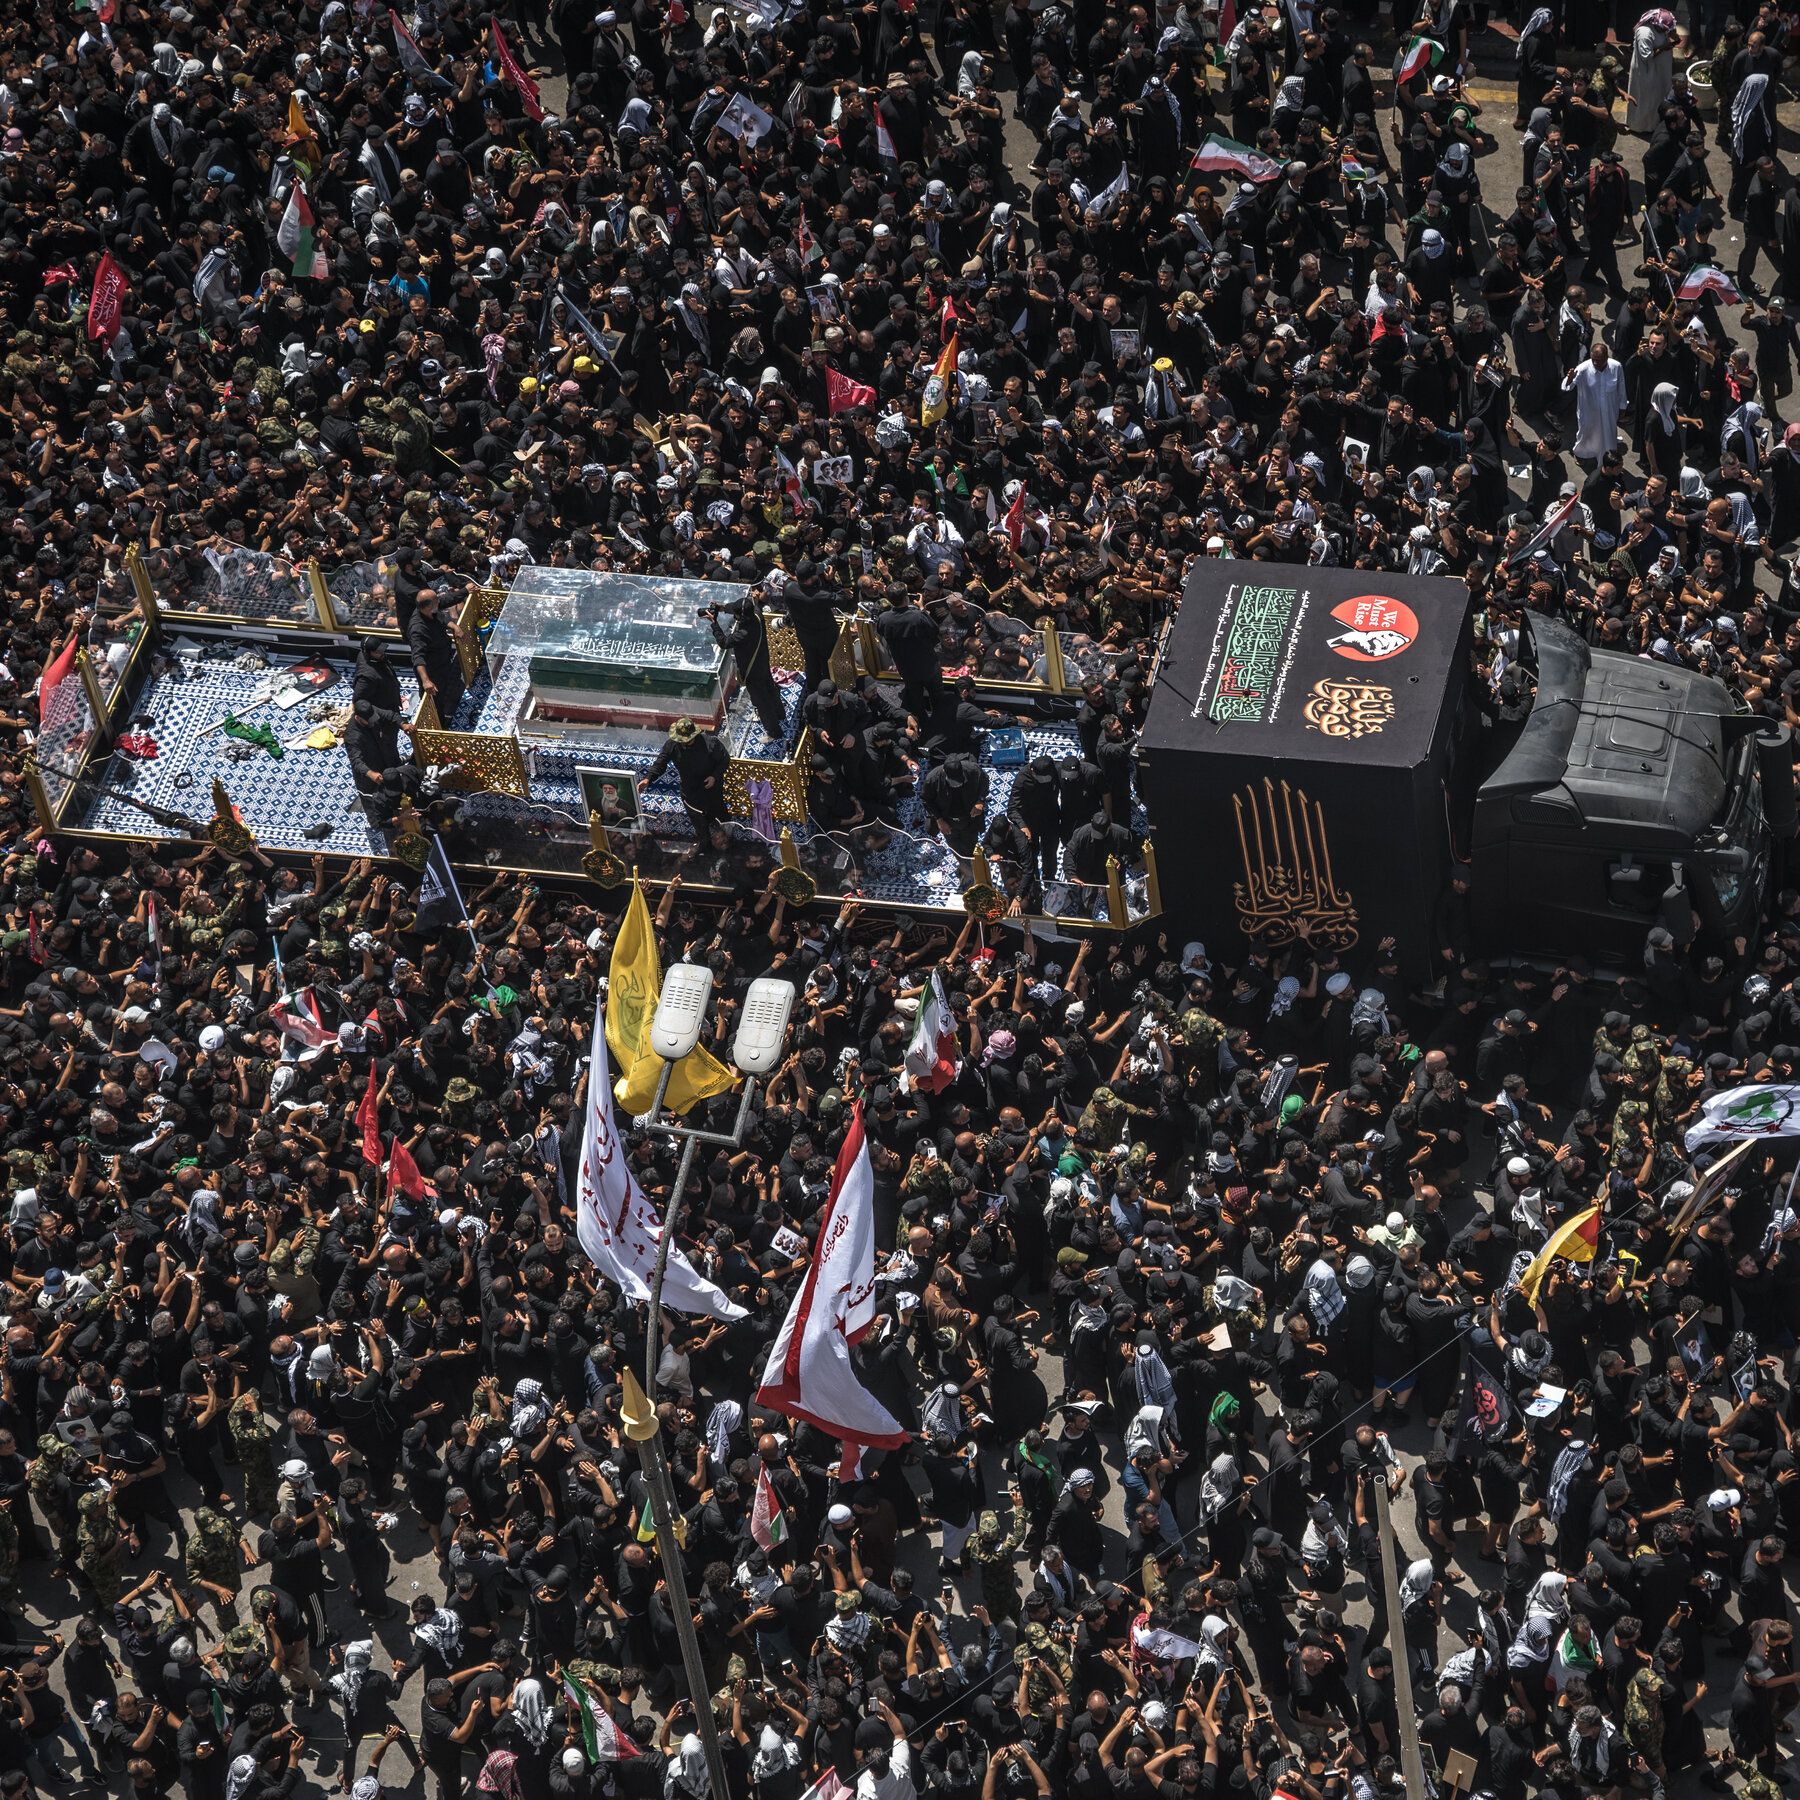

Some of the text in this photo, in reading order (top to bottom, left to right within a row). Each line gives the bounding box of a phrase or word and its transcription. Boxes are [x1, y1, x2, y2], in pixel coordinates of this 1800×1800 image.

[1353, 601, 1372, 626] Rise
[1368, 598, 1389, 627] Must
[1380, 609, 1398, 628] We
[1267, 590, 1311, 724] مراسم توديع وتشييع ومواراة جثمان الإمام المجاهد الشهيد
[1217, 657, 1261, 698] الشهيد
